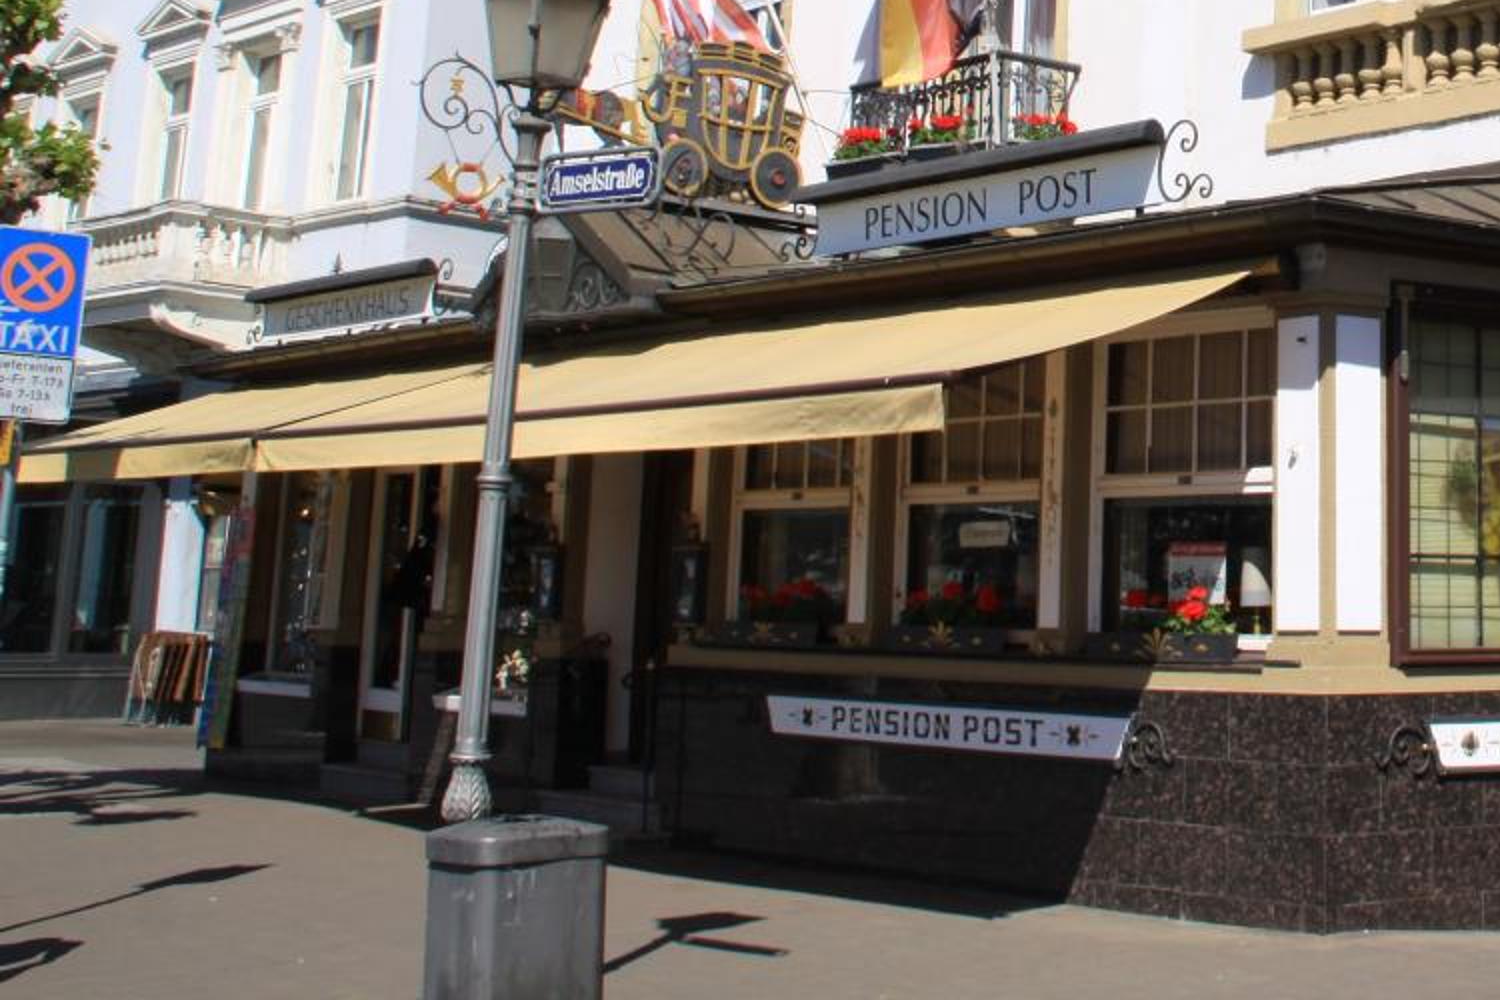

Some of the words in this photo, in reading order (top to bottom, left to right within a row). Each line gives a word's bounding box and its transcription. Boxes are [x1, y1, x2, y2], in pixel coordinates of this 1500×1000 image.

[549, 162, 646, 197] Amselstraße
[864, 187, 988, 241] PENSION
[1018, 167, 1097, 216] POST
[0, 320, 70, 353] TAXI
[831, 705, 951, 741] PENSION
[962, 715, 1044, 748] POST
